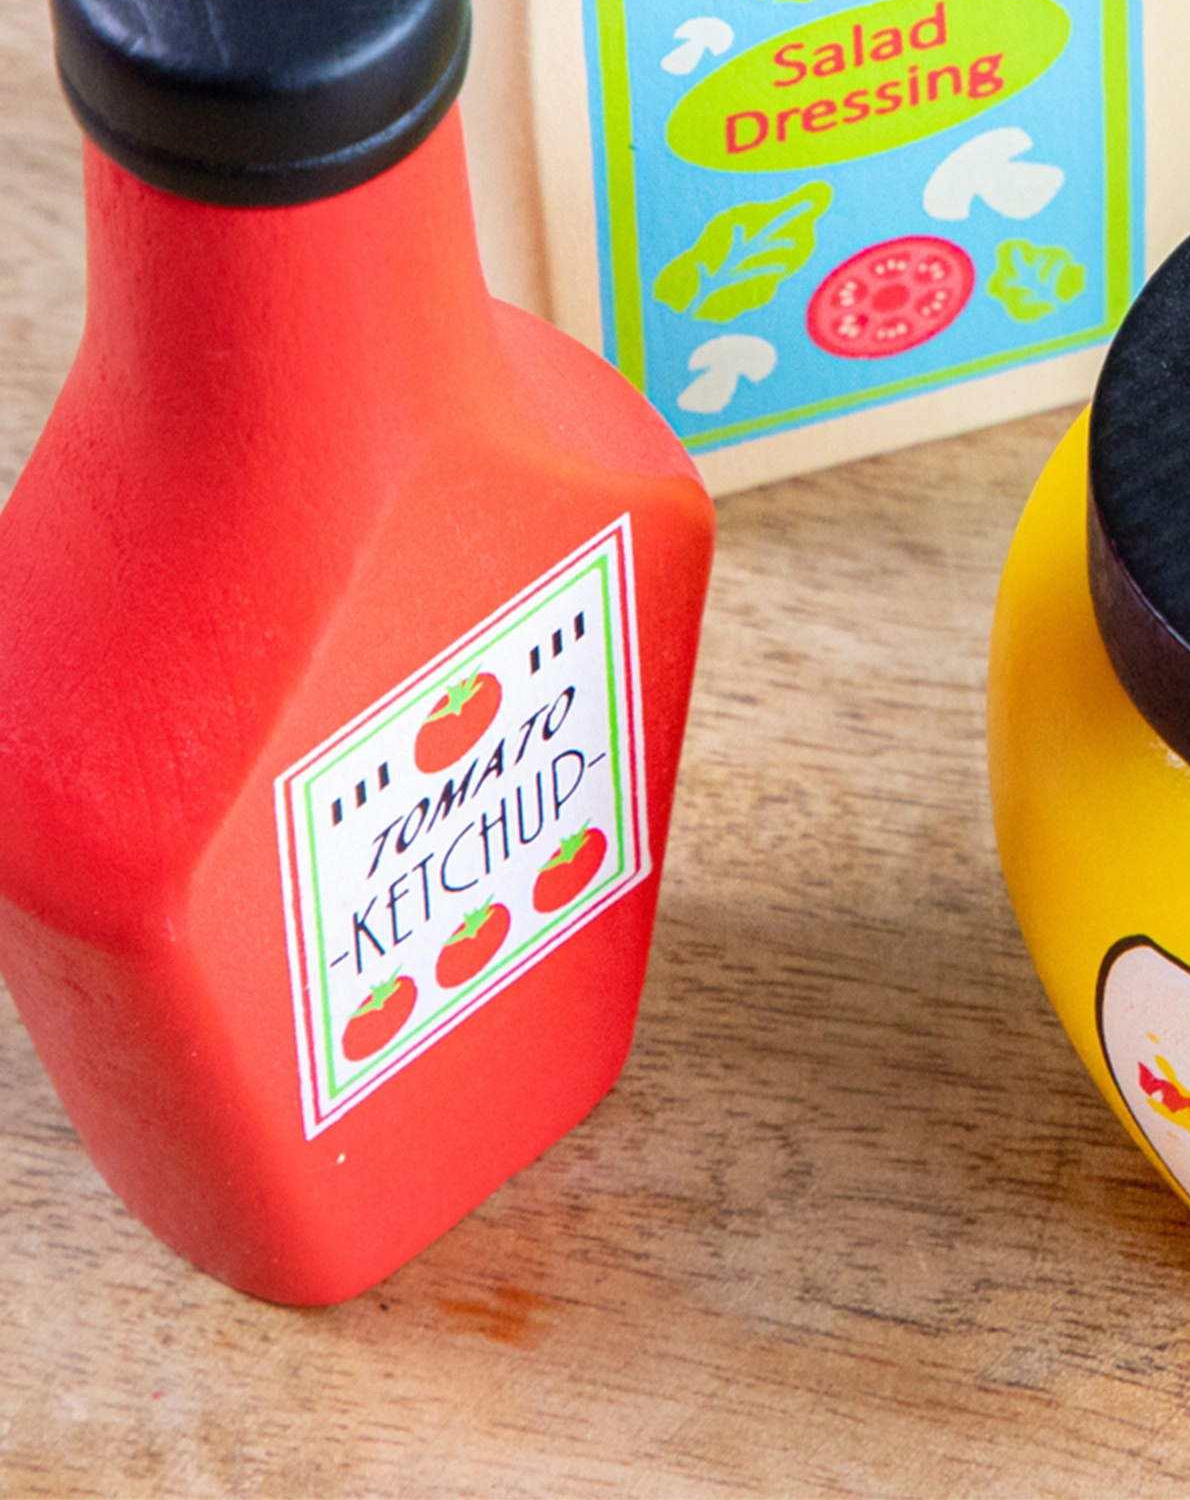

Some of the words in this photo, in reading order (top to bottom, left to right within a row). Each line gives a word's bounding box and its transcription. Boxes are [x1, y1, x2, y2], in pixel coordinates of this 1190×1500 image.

[773, 1, 947, 88] Salad
[725, 52, 1005, 155] Dressing
[367, 685, 576, 880] TOMATO
